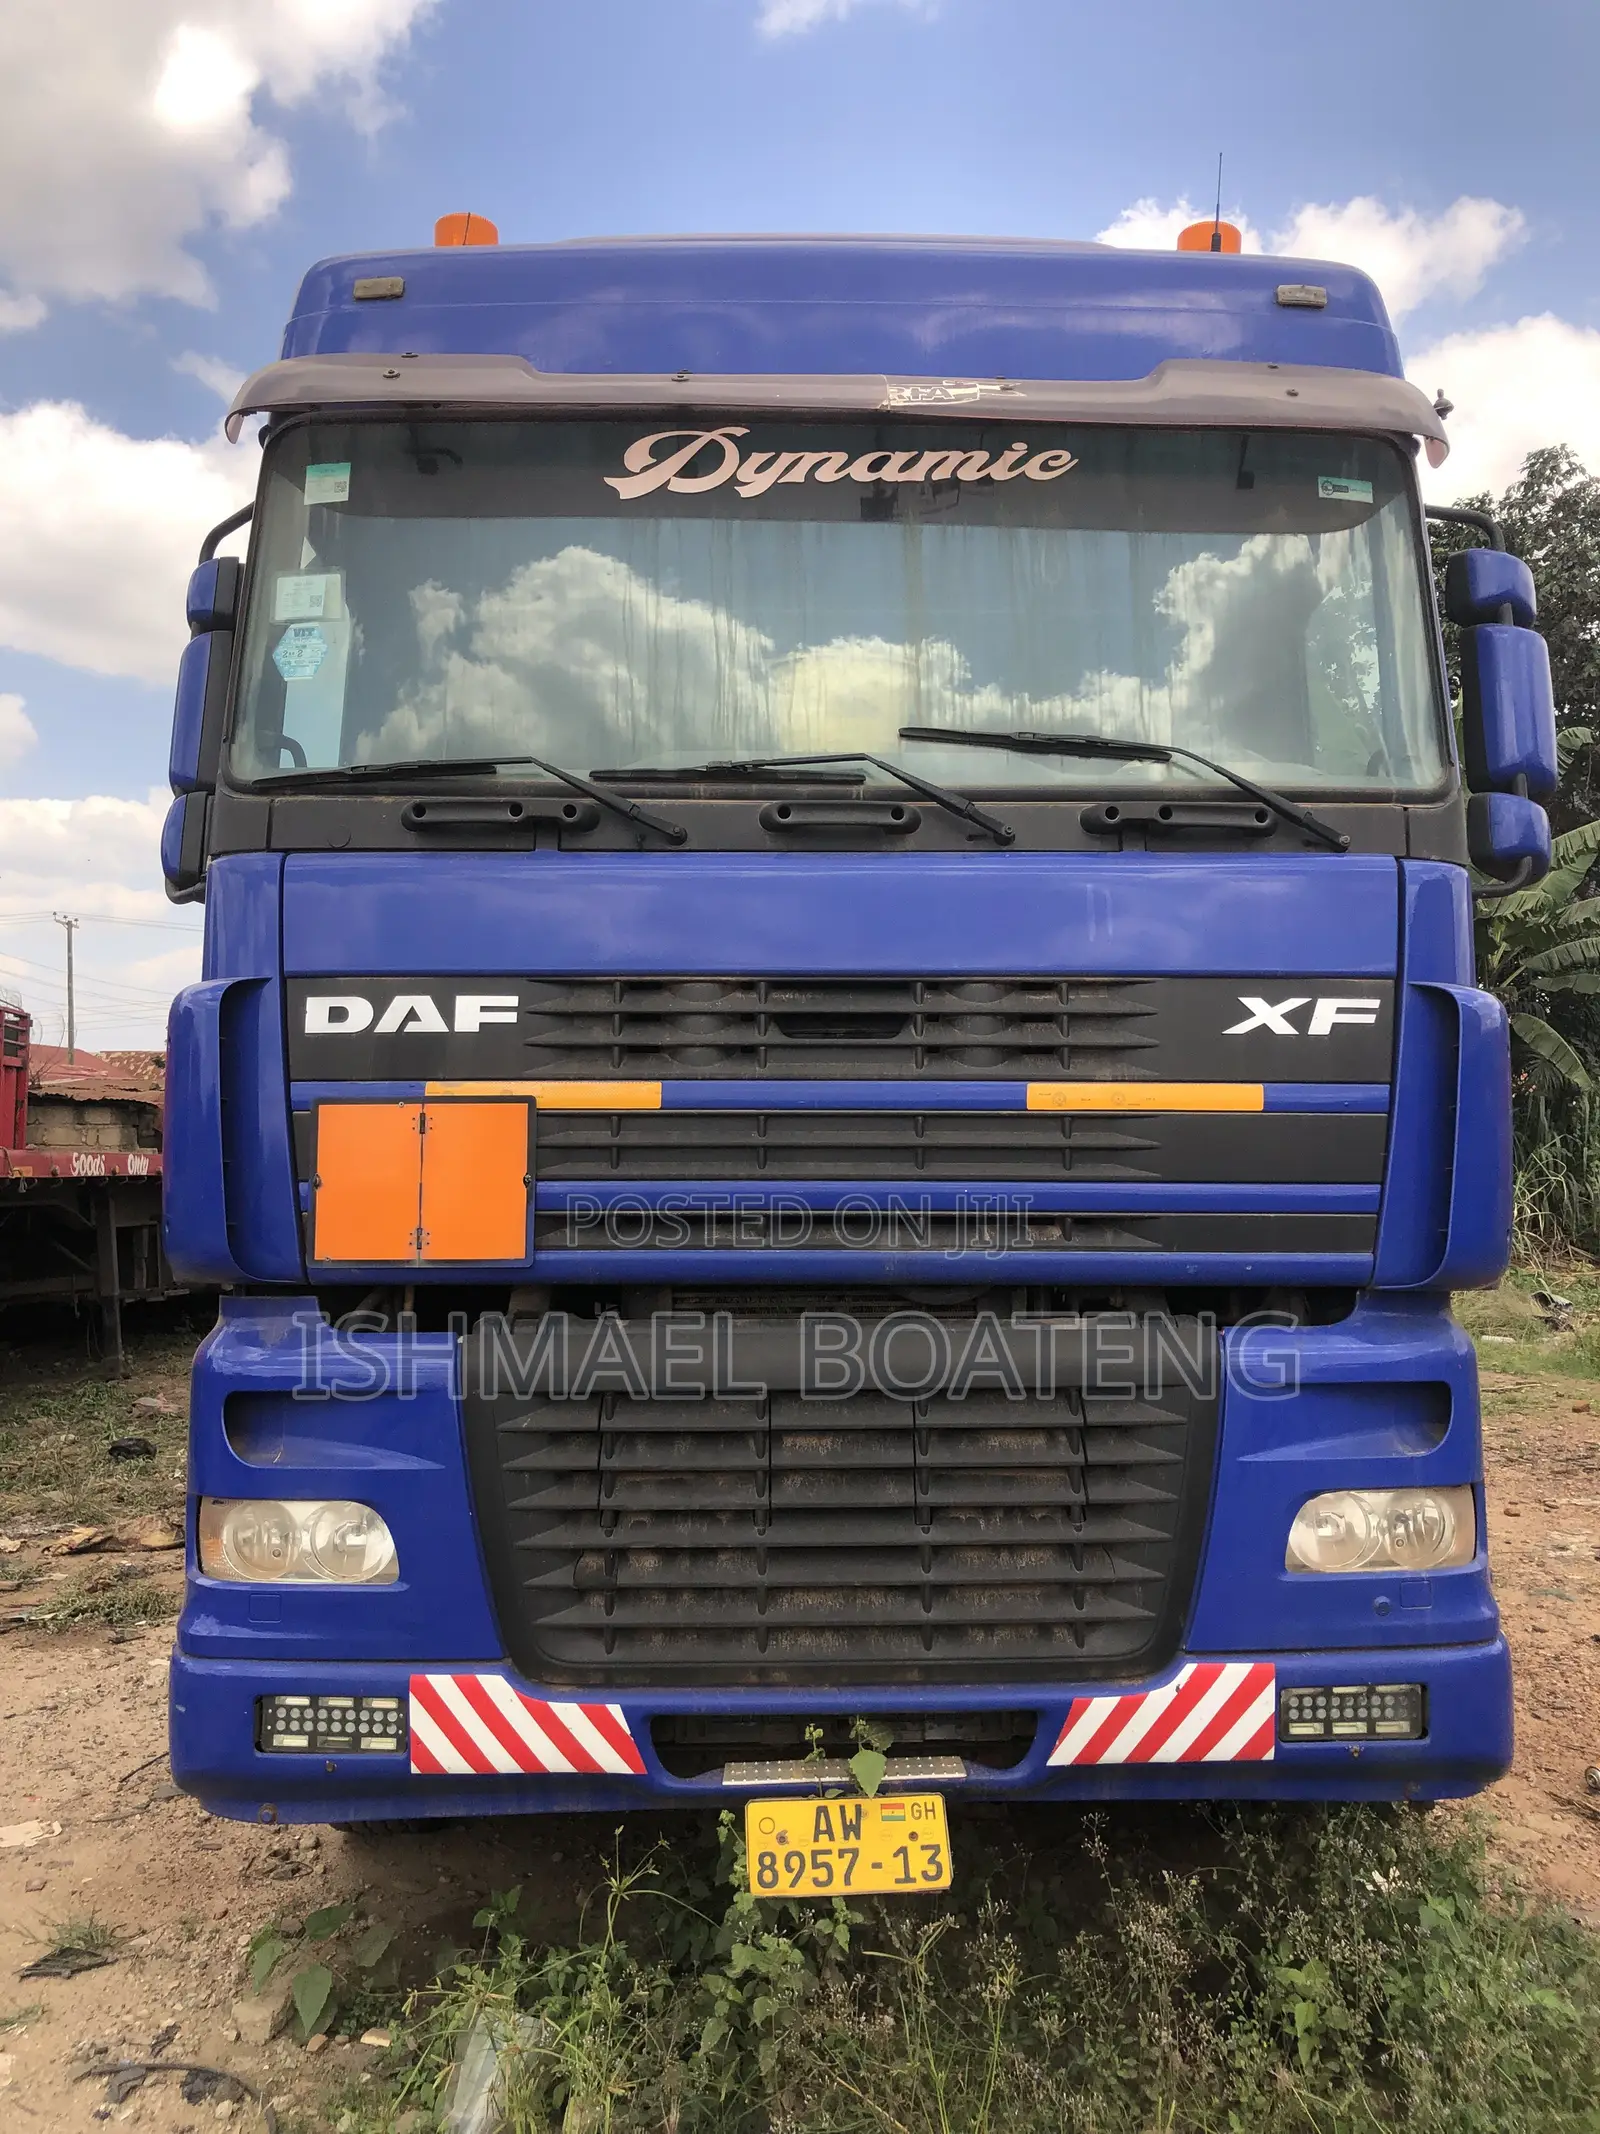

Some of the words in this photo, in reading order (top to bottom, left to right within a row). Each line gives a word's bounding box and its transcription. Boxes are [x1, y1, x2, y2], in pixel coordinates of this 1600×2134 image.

[603, 426, 1080, 500] Dynamic
[304, 995, 520, 1034] DAF
[1221, 996, 1381, 1036] XF
[813, 1804, 862, 1843] AW
[910, 1801, 937, 1821] GH
